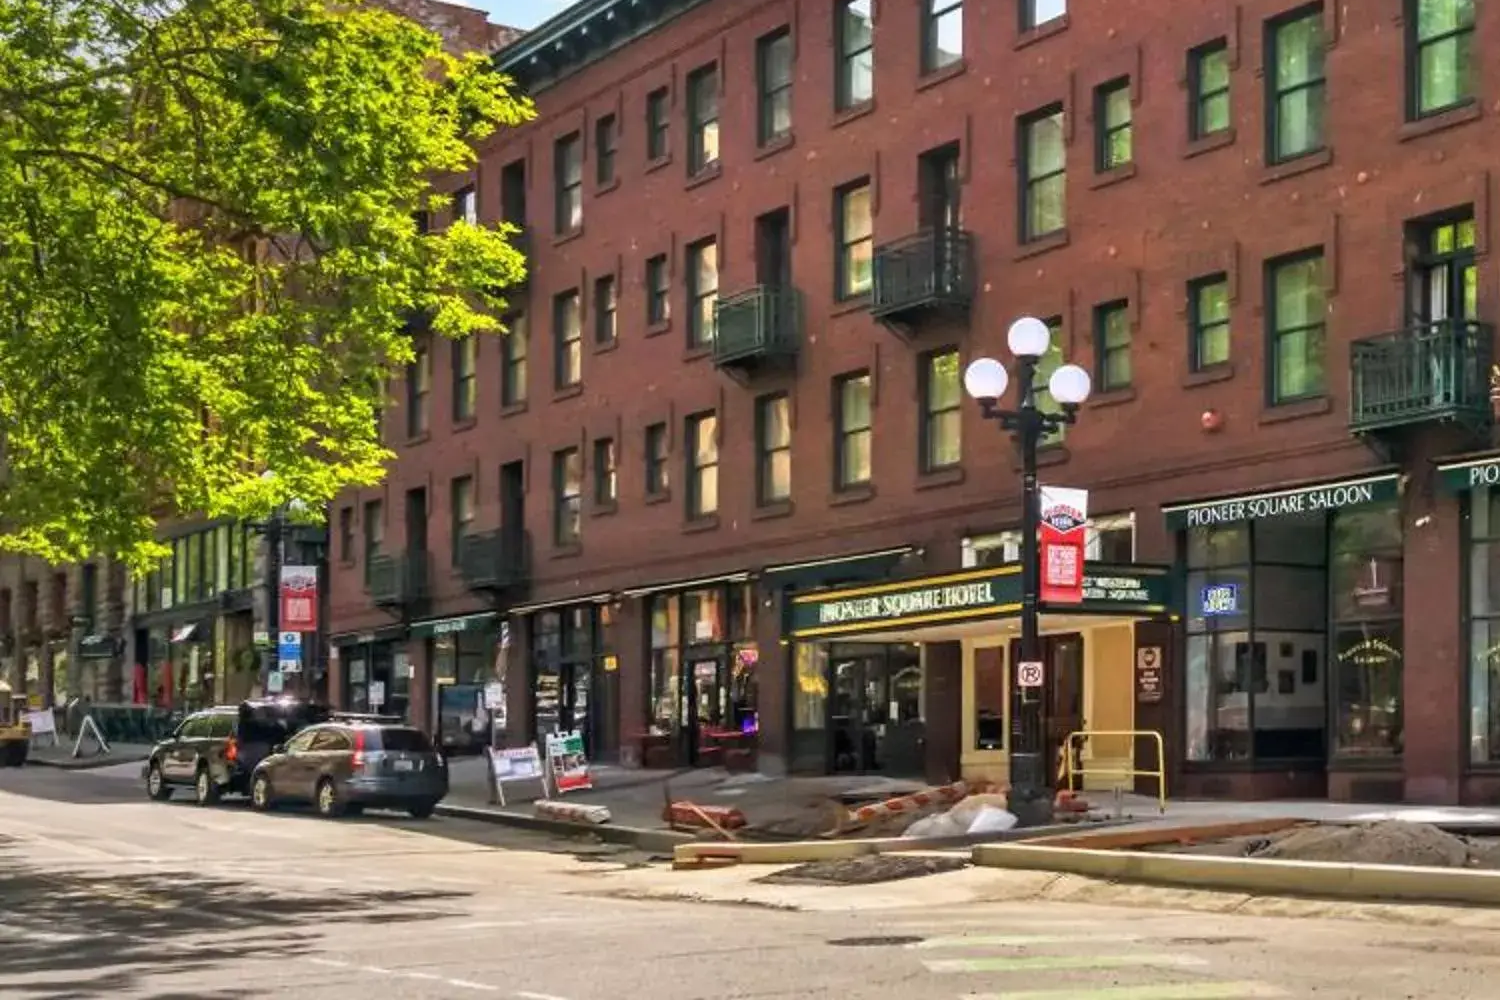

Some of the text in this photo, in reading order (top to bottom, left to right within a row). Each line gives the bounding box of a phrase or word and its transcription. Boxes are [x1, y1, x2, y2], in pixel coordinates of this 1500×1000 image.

[1187, 484, 1373, 527] PIONEER SQUARE SALOON
[882, 588, 942, 617] SQUARE
[943, 581, 995, 607] HOTEL
